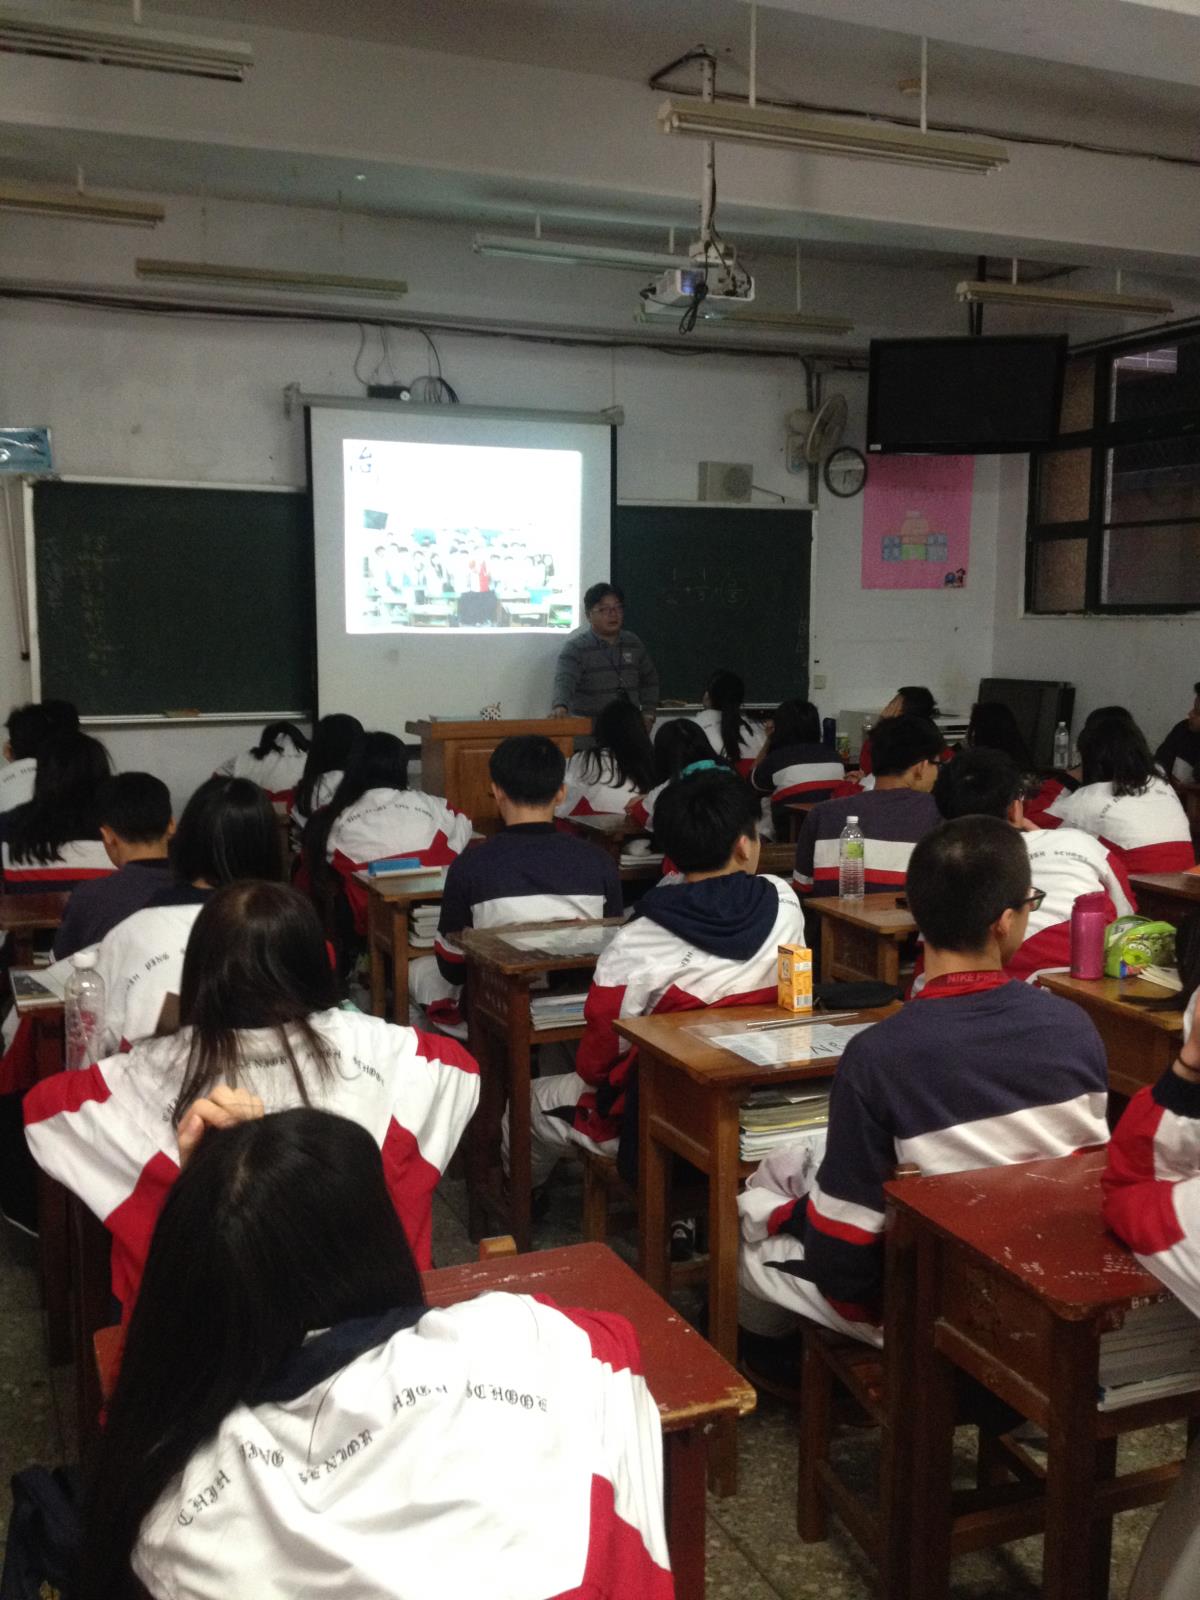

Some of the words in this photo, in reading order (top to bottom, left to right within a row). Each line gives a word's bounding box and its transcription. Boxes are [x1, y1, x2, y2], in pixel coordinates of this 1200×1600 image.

[177, 1469, 231, 1526] CHIH
[298, 1428, 374, 1485] SENIOR
[465, 1379, 548, 1412] SCHOOL
